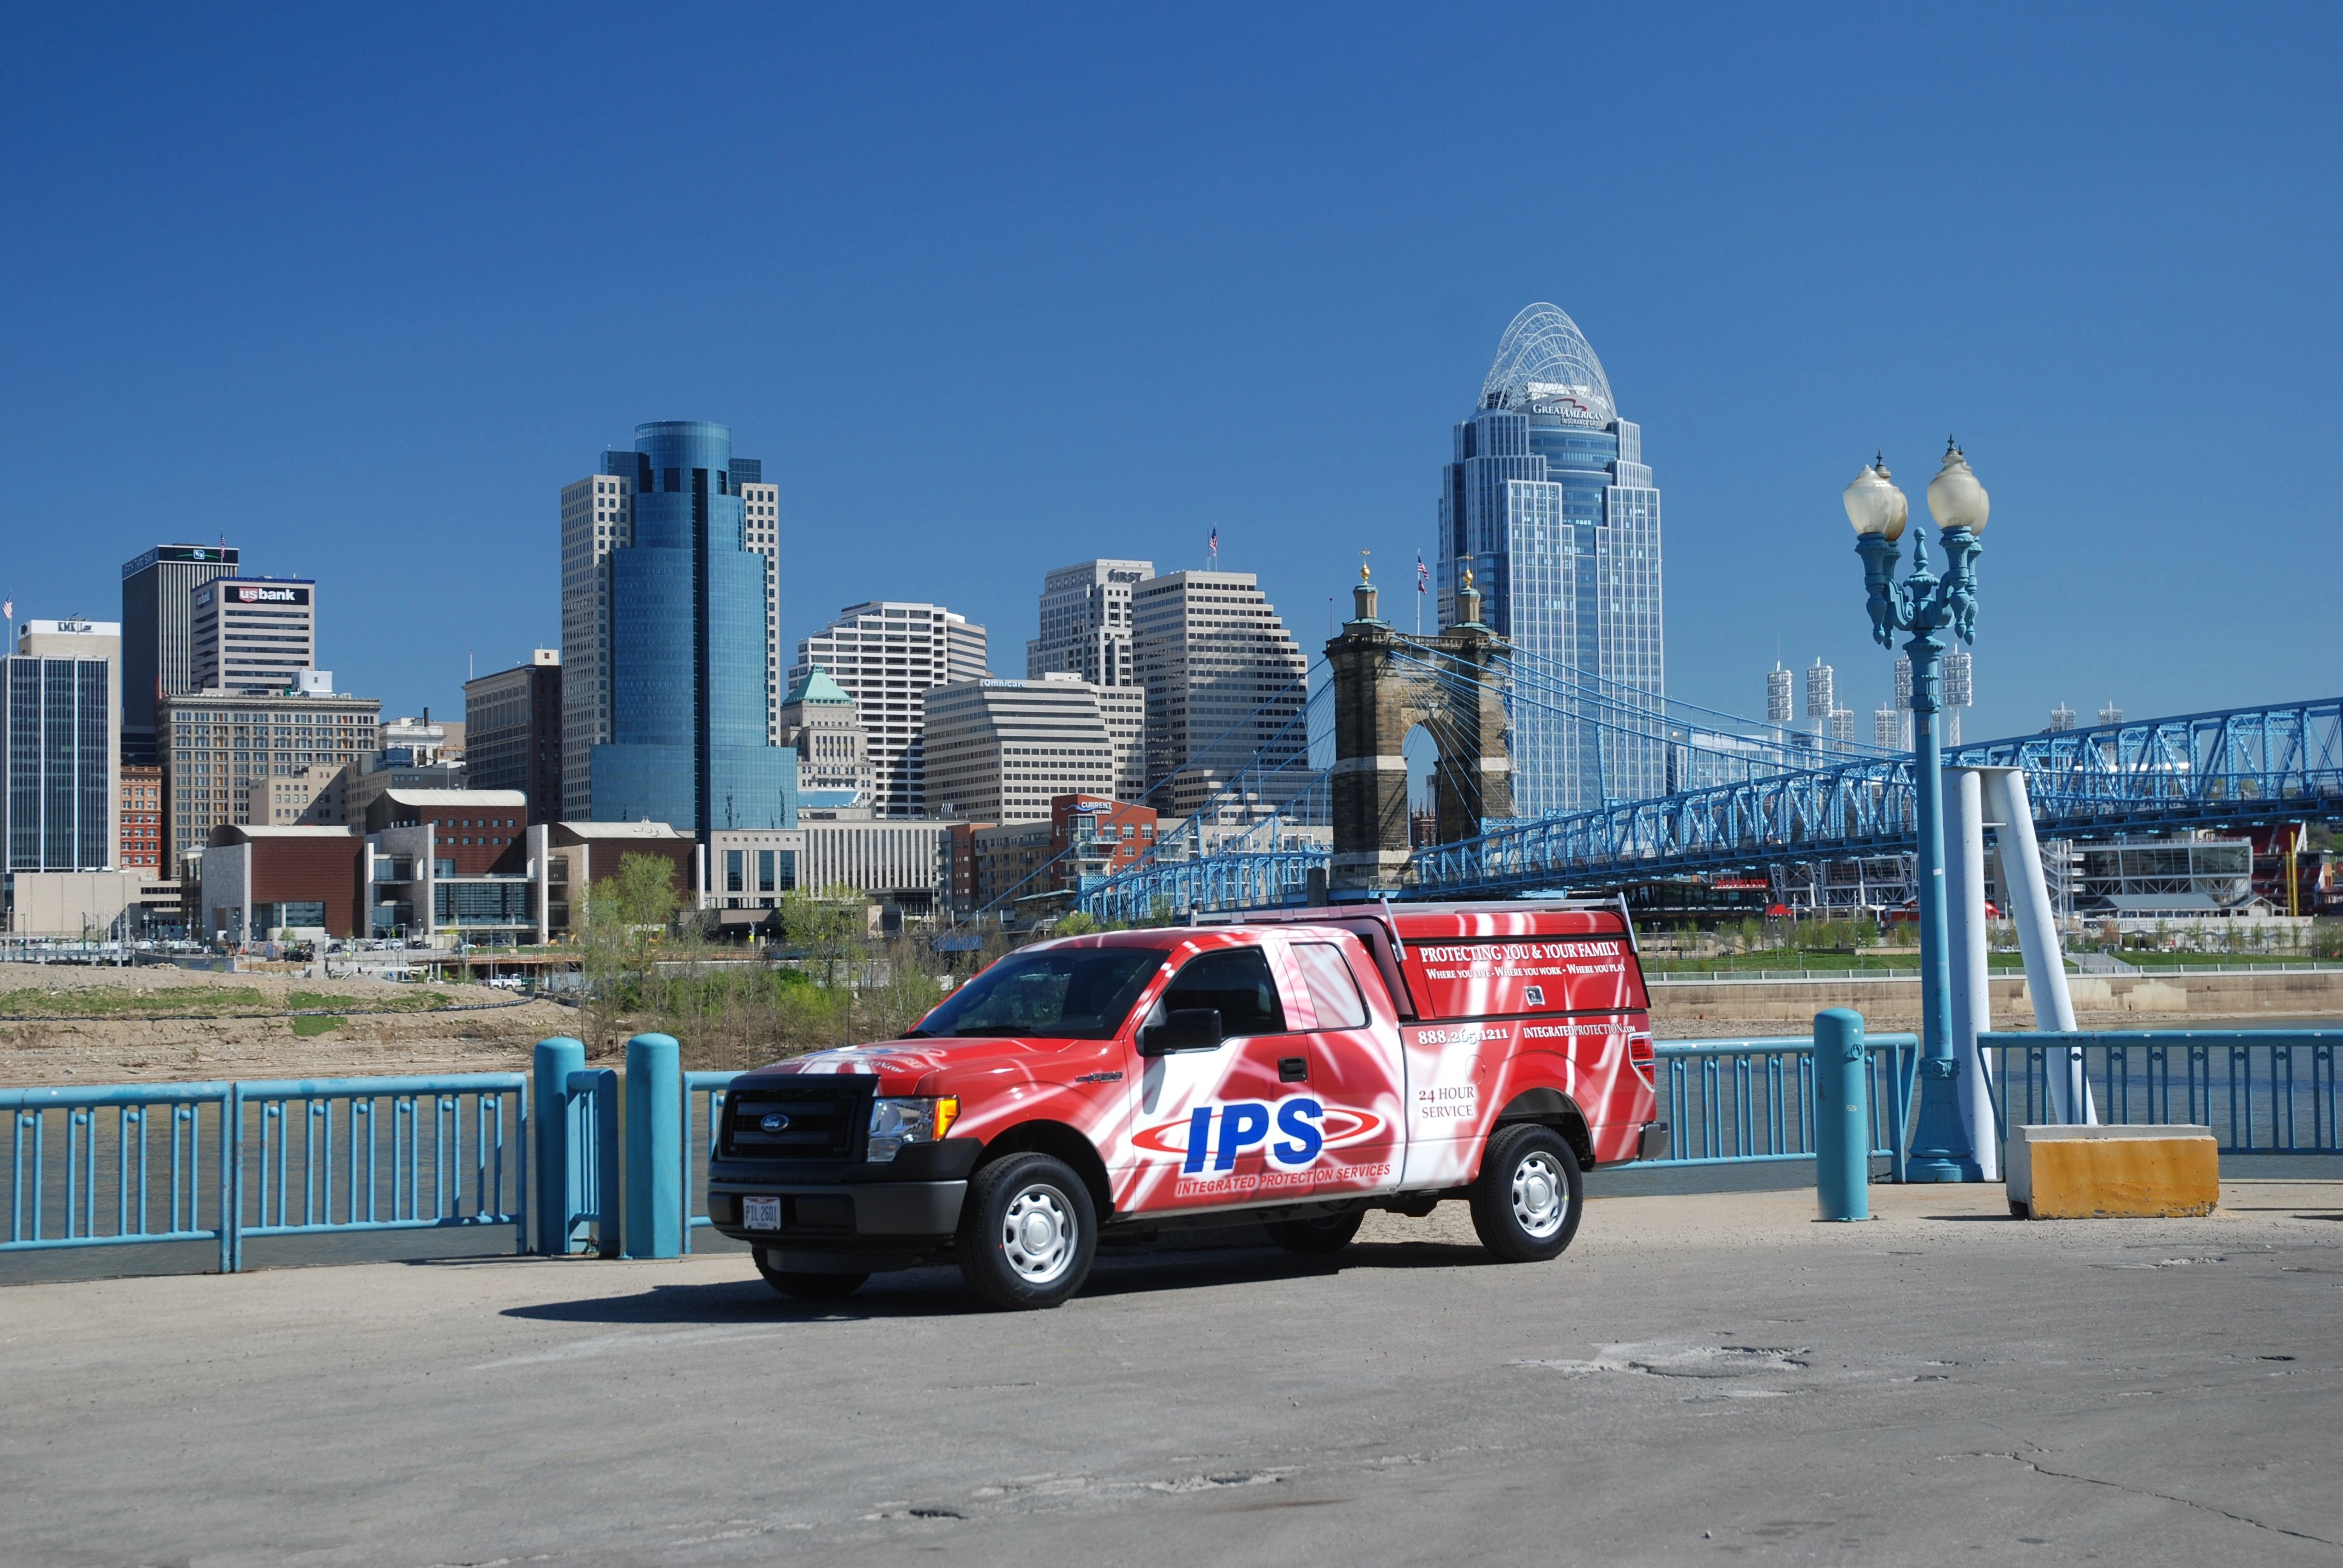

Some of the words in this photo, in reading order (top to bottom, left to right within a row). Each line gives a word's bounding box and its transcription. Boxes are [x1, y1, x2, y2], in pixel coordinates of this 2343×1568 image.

[57, 622, 76, 632] KMK
[984, 679, 1027, 687] Omnicare
[1081, 802, 1112, 810] CURRENT
[1715, 879, 1768, 887] MOERLEIN
[1420, 946, 1502, 962] PROTECTING
[1502, 945, 1530, 961] YOU
[1532, 944, 1542, 959] &
[1542, 943, 1578, 959] YOUR
[1577, 941, 1620, 958] FAMILY
[1426, 969, 1457, 979] WHERE
[1457, 969, 1473, 979] YOU
[1473, 969, 1491, 978] LIVE
[1493, 966, 1524, 977] WHERE
[1539, 967, 1562, 976] WORK
[1566, 964, 1594, 975] WHERE
[1593, 964, 1610, 973] YOU
[1418, 1028, 1509, 1045] 888.265.1211
[1522, 1023, 1636, 1038] INTEGRATEDPROTECTION.COM
[1419, 1090, 1435, 1103] 24
[1439, 1086, 1475, 1099] HOUR
[1422, 1105, 1473, 1119] SERVICE
[1183, 1098, 1323, 1174] IPS
[1178, 1176, 1256, 1195] INTEGRATED
[1259, 1170, 1333, 1187] PROTECTION
[1336, 1164, 1391, 1179] SERVICES
[746, 1205, 759, 1221] PIL
